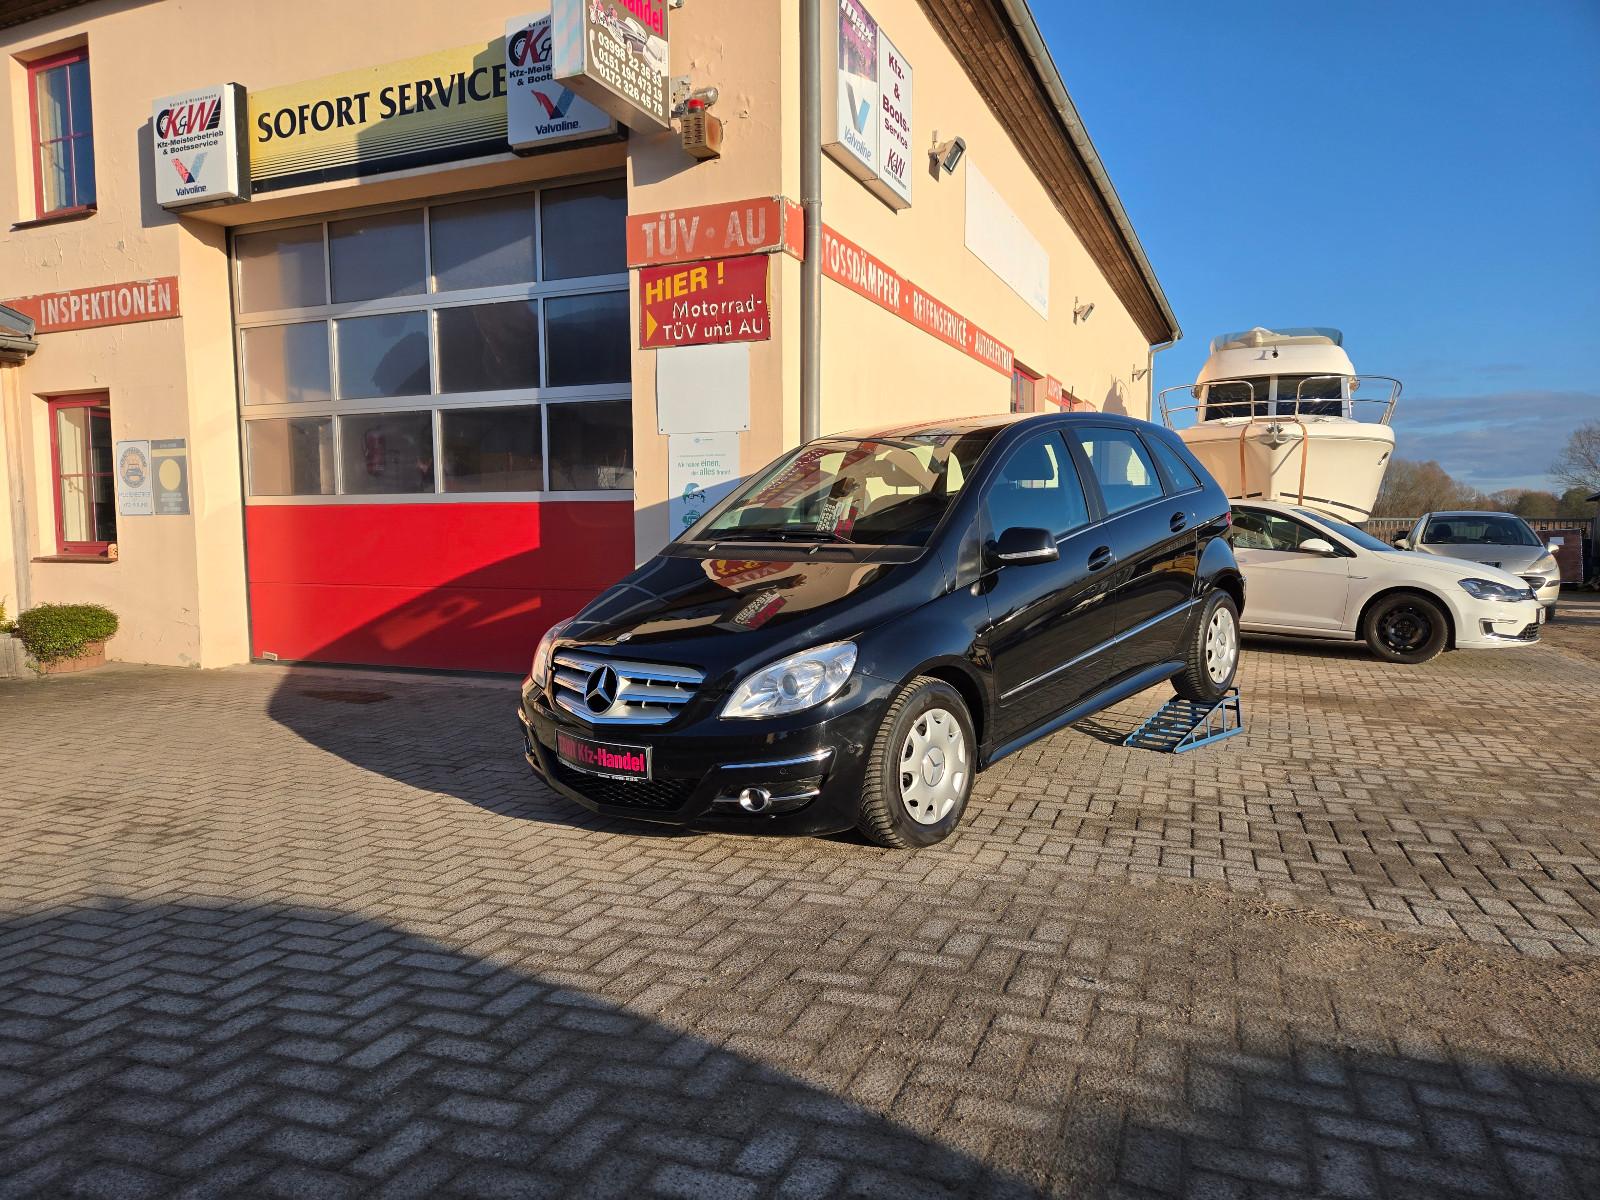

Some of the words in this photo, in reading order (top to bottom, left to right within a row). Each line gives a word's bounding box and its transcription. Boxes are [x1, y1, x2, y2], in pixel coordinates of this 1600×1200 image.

[618, 0, 664, 36] andel
[509, 64, 552, 79] Kfz-Meis
[598, 32, 626, 62] 03998
[628, 54, 639, 72] 22
[641, 63, 651, 80] 36
[888, 51, 905, 80] Kfz-
[599, 47, 619, 73] 0151
[622, 64, 636, 84] 194
[638, 75, 651, 95] 473
[653, 87, 663, 102] 19
[599, 64, 621, 89] 0172
[623, 80, 639, 101] 326
[641, 92, 651, 109] 45
[652, 99, 663, 117] 79
[257, 91, 370, 142] SOFORT
[379, 64, 508, 119] SERVICE
[893, 83, 900, 102] &
[535, 120, 579, 136] Valvoline
[882, 93, 910, 134] Boots-
[157, 130, 224, 149] Kfz-Meisterbetrieb
[170, 140, 218, 154] Bootsservice
[844, 125, 872, 162] Valvoline
[884, 118, 908, 150] Service
[175, 185, 207, 196] Valvoline
[642, 212, 699, 258] TÜV
[724, 207, 766, 248] AU
[645, 266, 708, 305] HIER
[717, 261, 724, 285] !
[821, 231, 900, 309] TOSSDÄMPFER
[913, 289, 967, 347] REIFENSERVICE
[40, 283, 171, 326] INSPEKTIONEN
[672, 294, 762, 320] Motorrad-
[662, 322, 697, 340] TÜV
[704, 321, 732, 338] und
[738, 318, 763, 335] AU
[577, 743, 645, 772] Kfz-Handel
